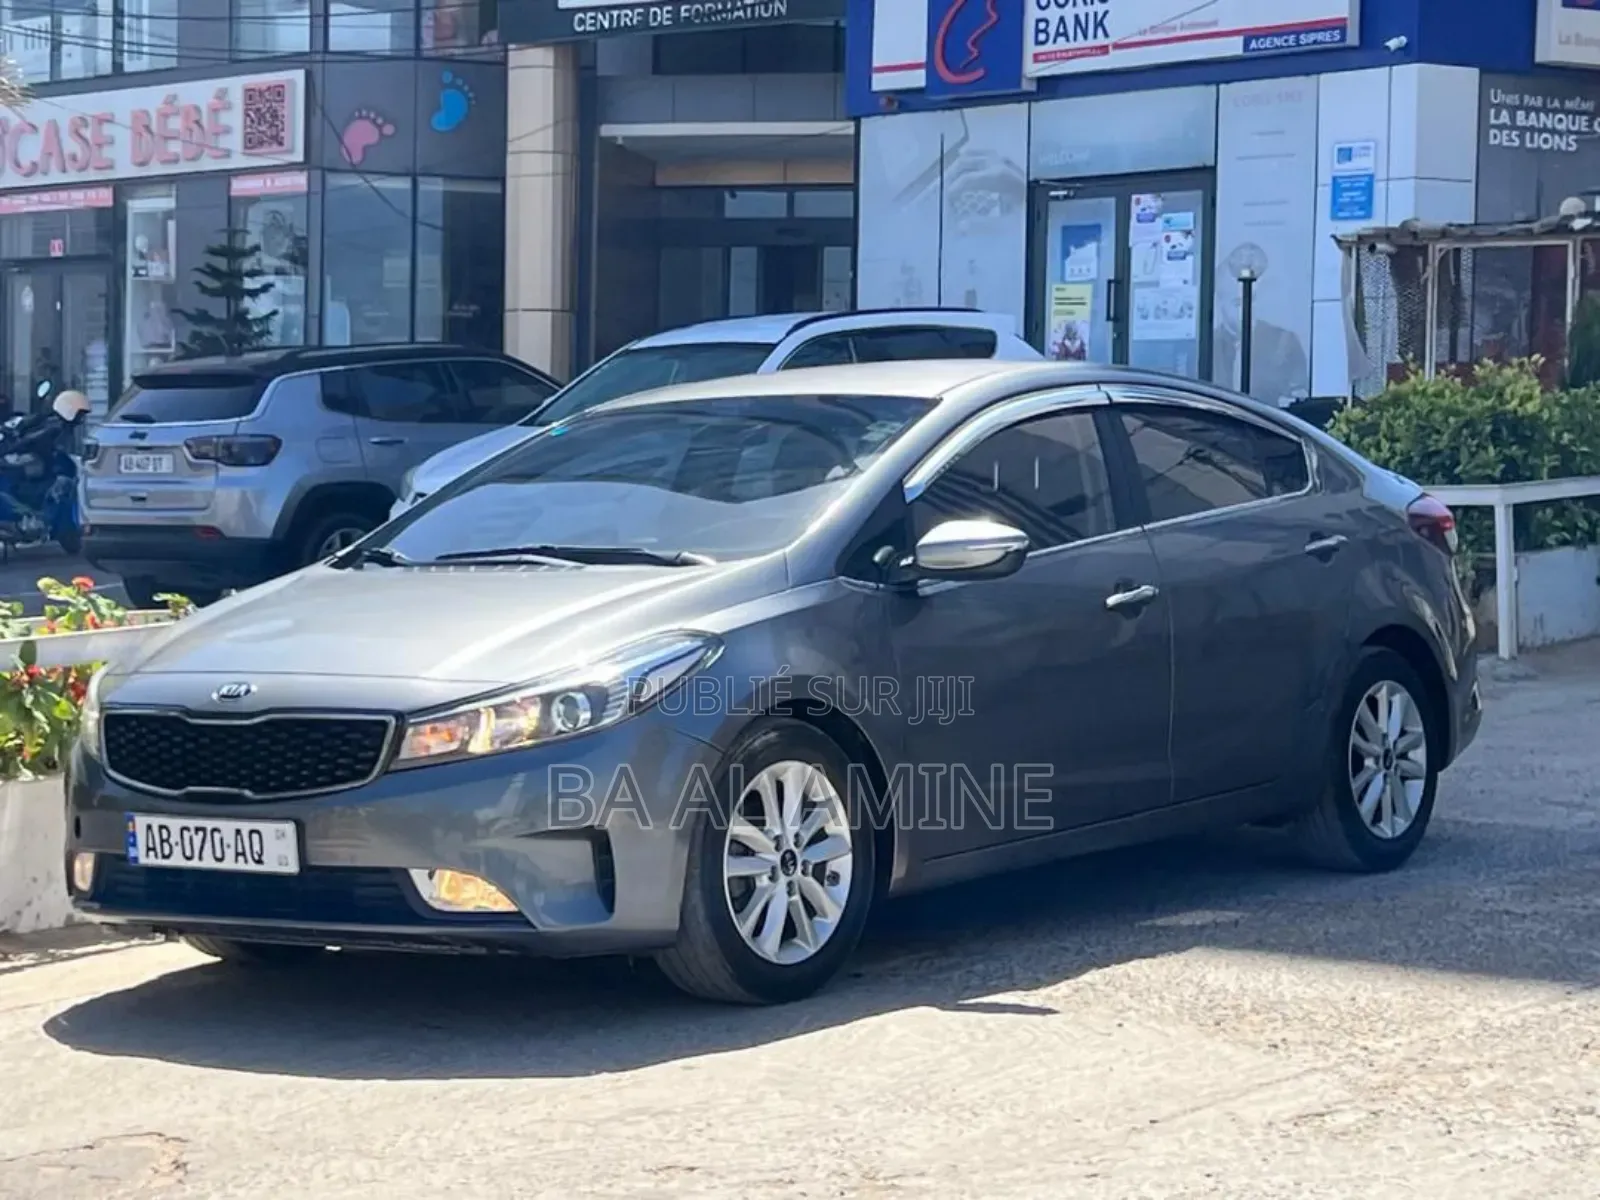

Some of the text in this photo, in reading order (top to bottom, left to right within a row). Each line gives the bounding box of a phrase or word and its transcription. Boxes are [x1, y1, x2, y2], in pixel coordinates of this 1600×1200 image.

[649, 5, 673, 27] DE
[1034, 9, 1110, 47] BANK
[1249, 34, 1297, 50] AGENCE
[129, 86, 233, 168] BÉBÉ
[1489, 107, 1511, 125] LA
[1516, 109, 1589, 132] BANQUE
[1488, 128, 1577, 151] DES LIONS
[218, 683, 250, 698] KIA
